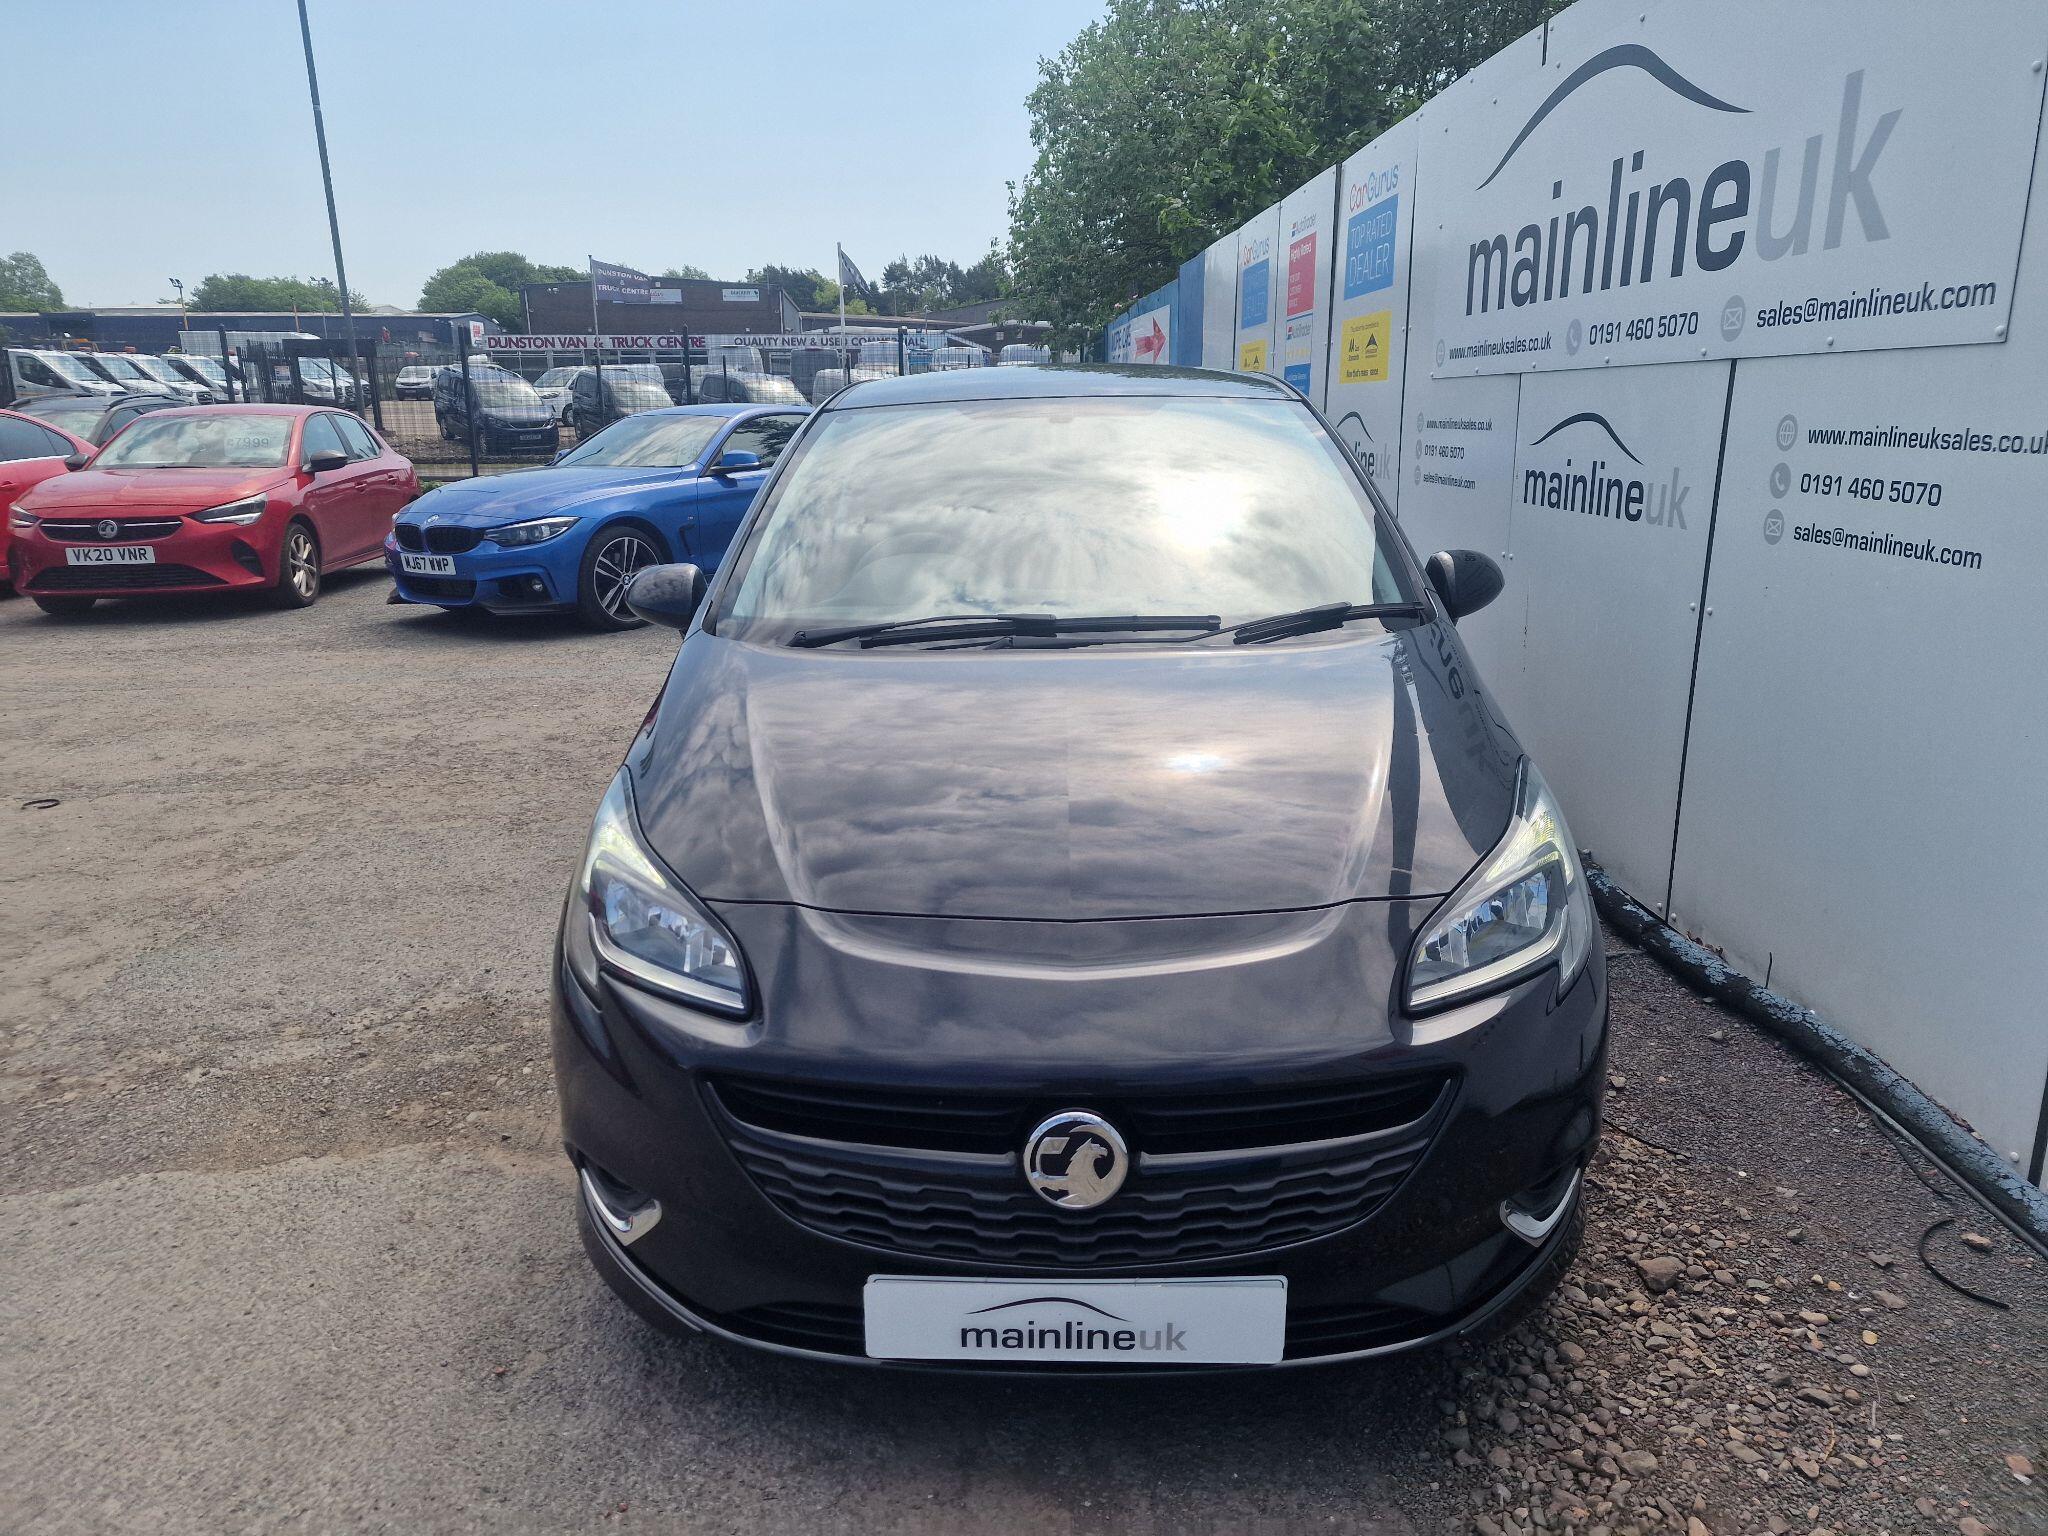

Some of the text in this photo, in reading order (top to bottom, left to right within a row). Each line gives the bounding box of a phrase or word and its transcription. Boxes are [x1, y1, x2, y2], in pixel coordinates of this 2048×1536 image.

[1349, 164, 1399, 213] CarGurus
[1465, 68, 1904, 317] mainlineuk
[1351, 210, 1393, 250] TOP RATED
[1349, 243, 1390, 286] DEALER
[596, 284, 619, 292] TRUCK
[621, 287, 649, 295] CENTRE
[1449, 281, 1996, 360] www.mainlineuksales.co.uk 0191 460 5070 sales@mainlineuk.com
[487, 336, 556, 348] DUNSTON
[557, 336, 587, 348] VAN
[609, 336, 652, 348] TRUCK
[657, 336, 706, 348] CENTRE
[733, 336, 779, 347] QUALITY
[781, 336, 807, 346] NEW
[810, 336, 817, 346] &
[820, 336, 848, 346] USED
[1449, 447, 1465, 460] 5070
[1523, 458, 1691, 530] mainlineuk
[1800, 473, 1942, 507] 0191 460 5070
[72, 547, 148, 562] VK20 VNR
[1793, 523, 1983, 569] sales@mainlineuk.com
[960, 1320, 1187, 1352] mainlineuk
